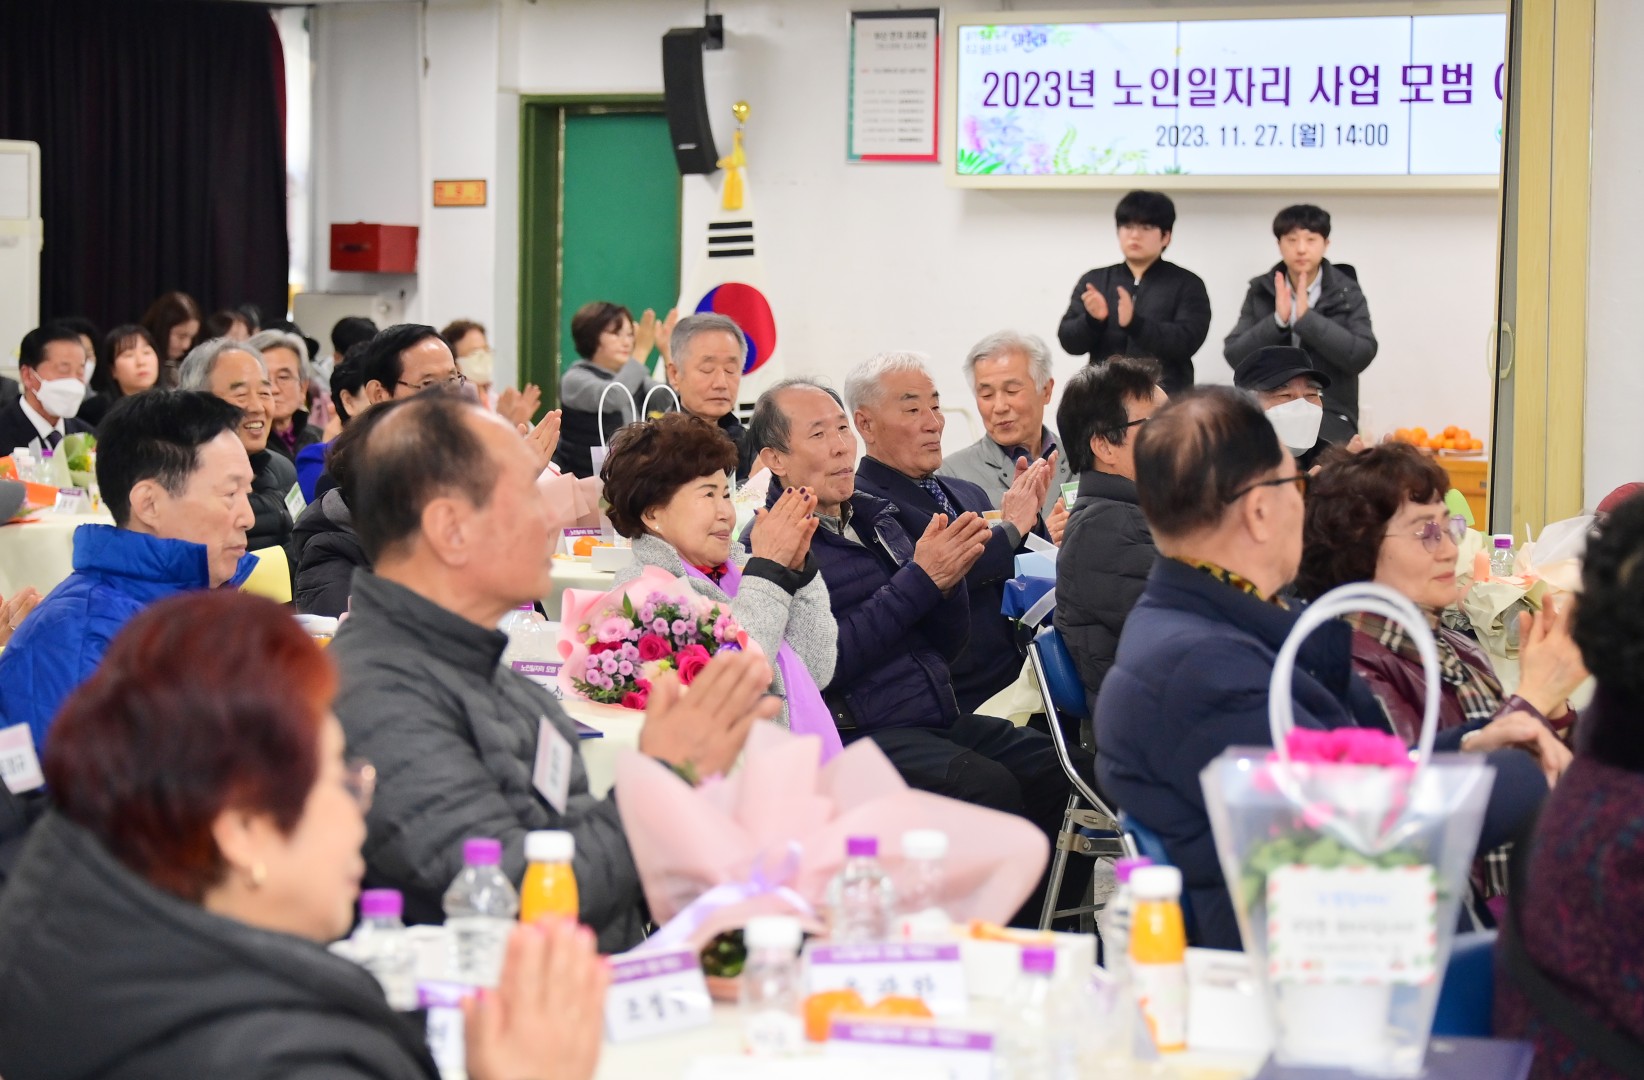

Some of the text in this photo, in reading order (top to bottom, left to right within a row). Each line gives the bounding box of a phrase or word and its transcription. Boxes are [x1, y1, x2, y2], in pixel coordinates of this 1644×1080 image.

[983, 69, 1095, 107] 2023년
[1114, 66, 1291, 107] 노인일자리
[1309, 65, 1380, 106] 사업
[1400, 63, 1473, 104] 모범
[1155, 125, 1209, 147] 2023.
[1220, 125, 1246, 146] 11.
[1254, 124, 1283, 146] 27.
[1335, 123, 1389, 146] 14:00
